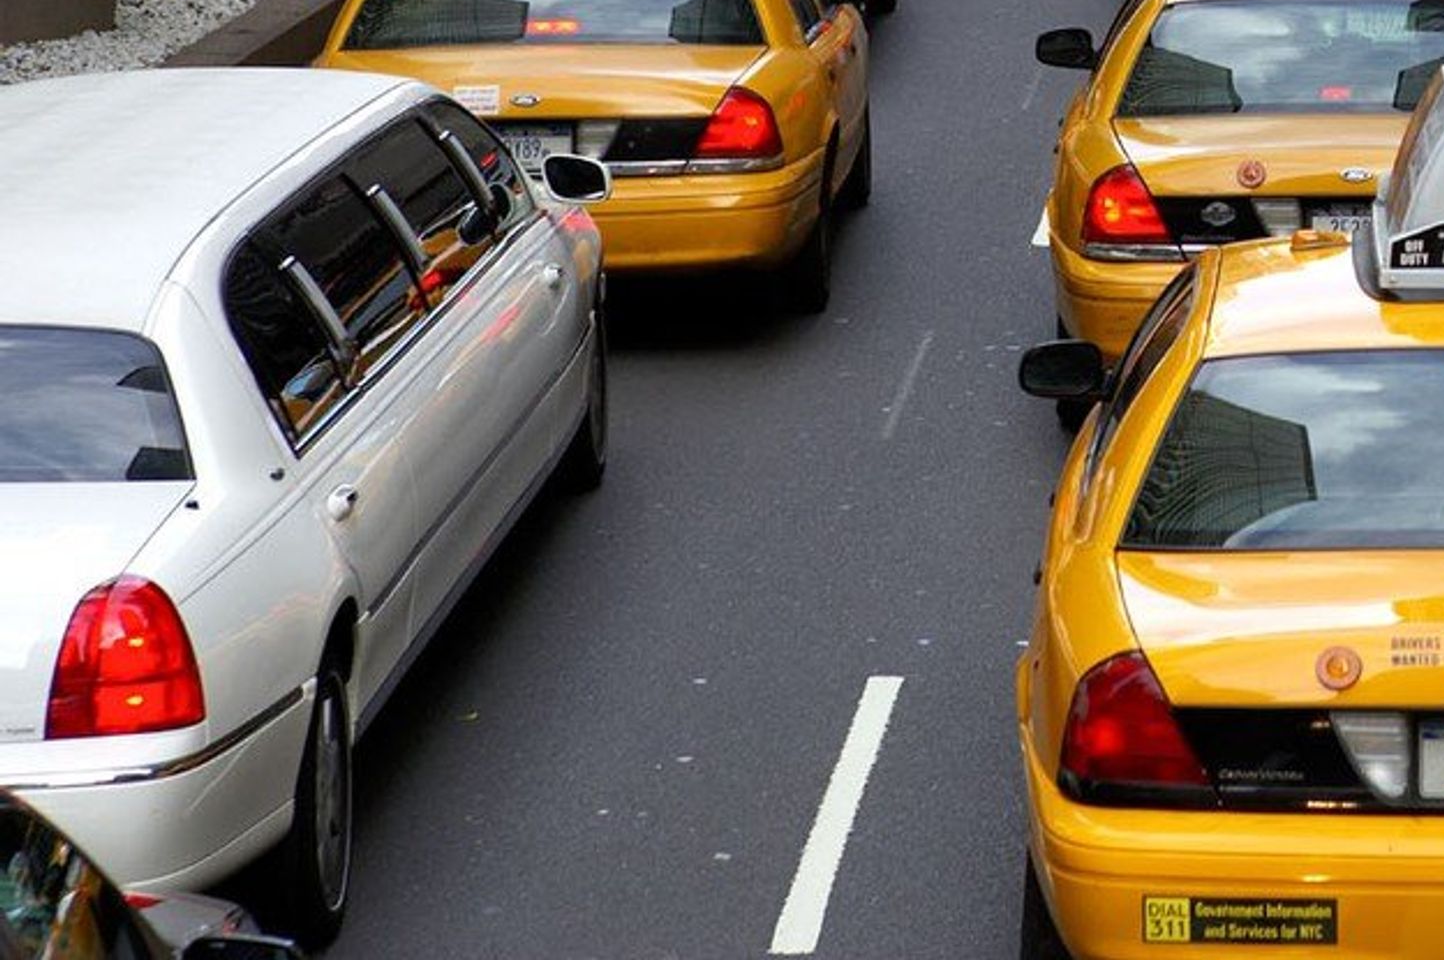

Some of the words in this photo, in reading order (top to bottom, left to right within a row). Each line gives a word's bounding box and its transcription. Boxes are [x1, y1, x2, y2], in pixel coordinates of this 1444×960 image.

[1405, 240, 1425, 252] OFF
[1400, 253, 1429, 266] DUTY
[1391, 637, 1440, 650] DRIVERS
[1391, 653, 1440, 666] WANTED
[1148, 903, 1186, 917] DIAL
[1195, 902, 1264, 917] Government
[1266, 903, 1332, 918] Information
[1150, 920, 1185, 937] 311
[1204, 924, 1225, 938] and
[1228, 924, 1278, 939] Services
[1280, 924, 1296, 939] for
[1300, 925, 1323, 939] NYC
